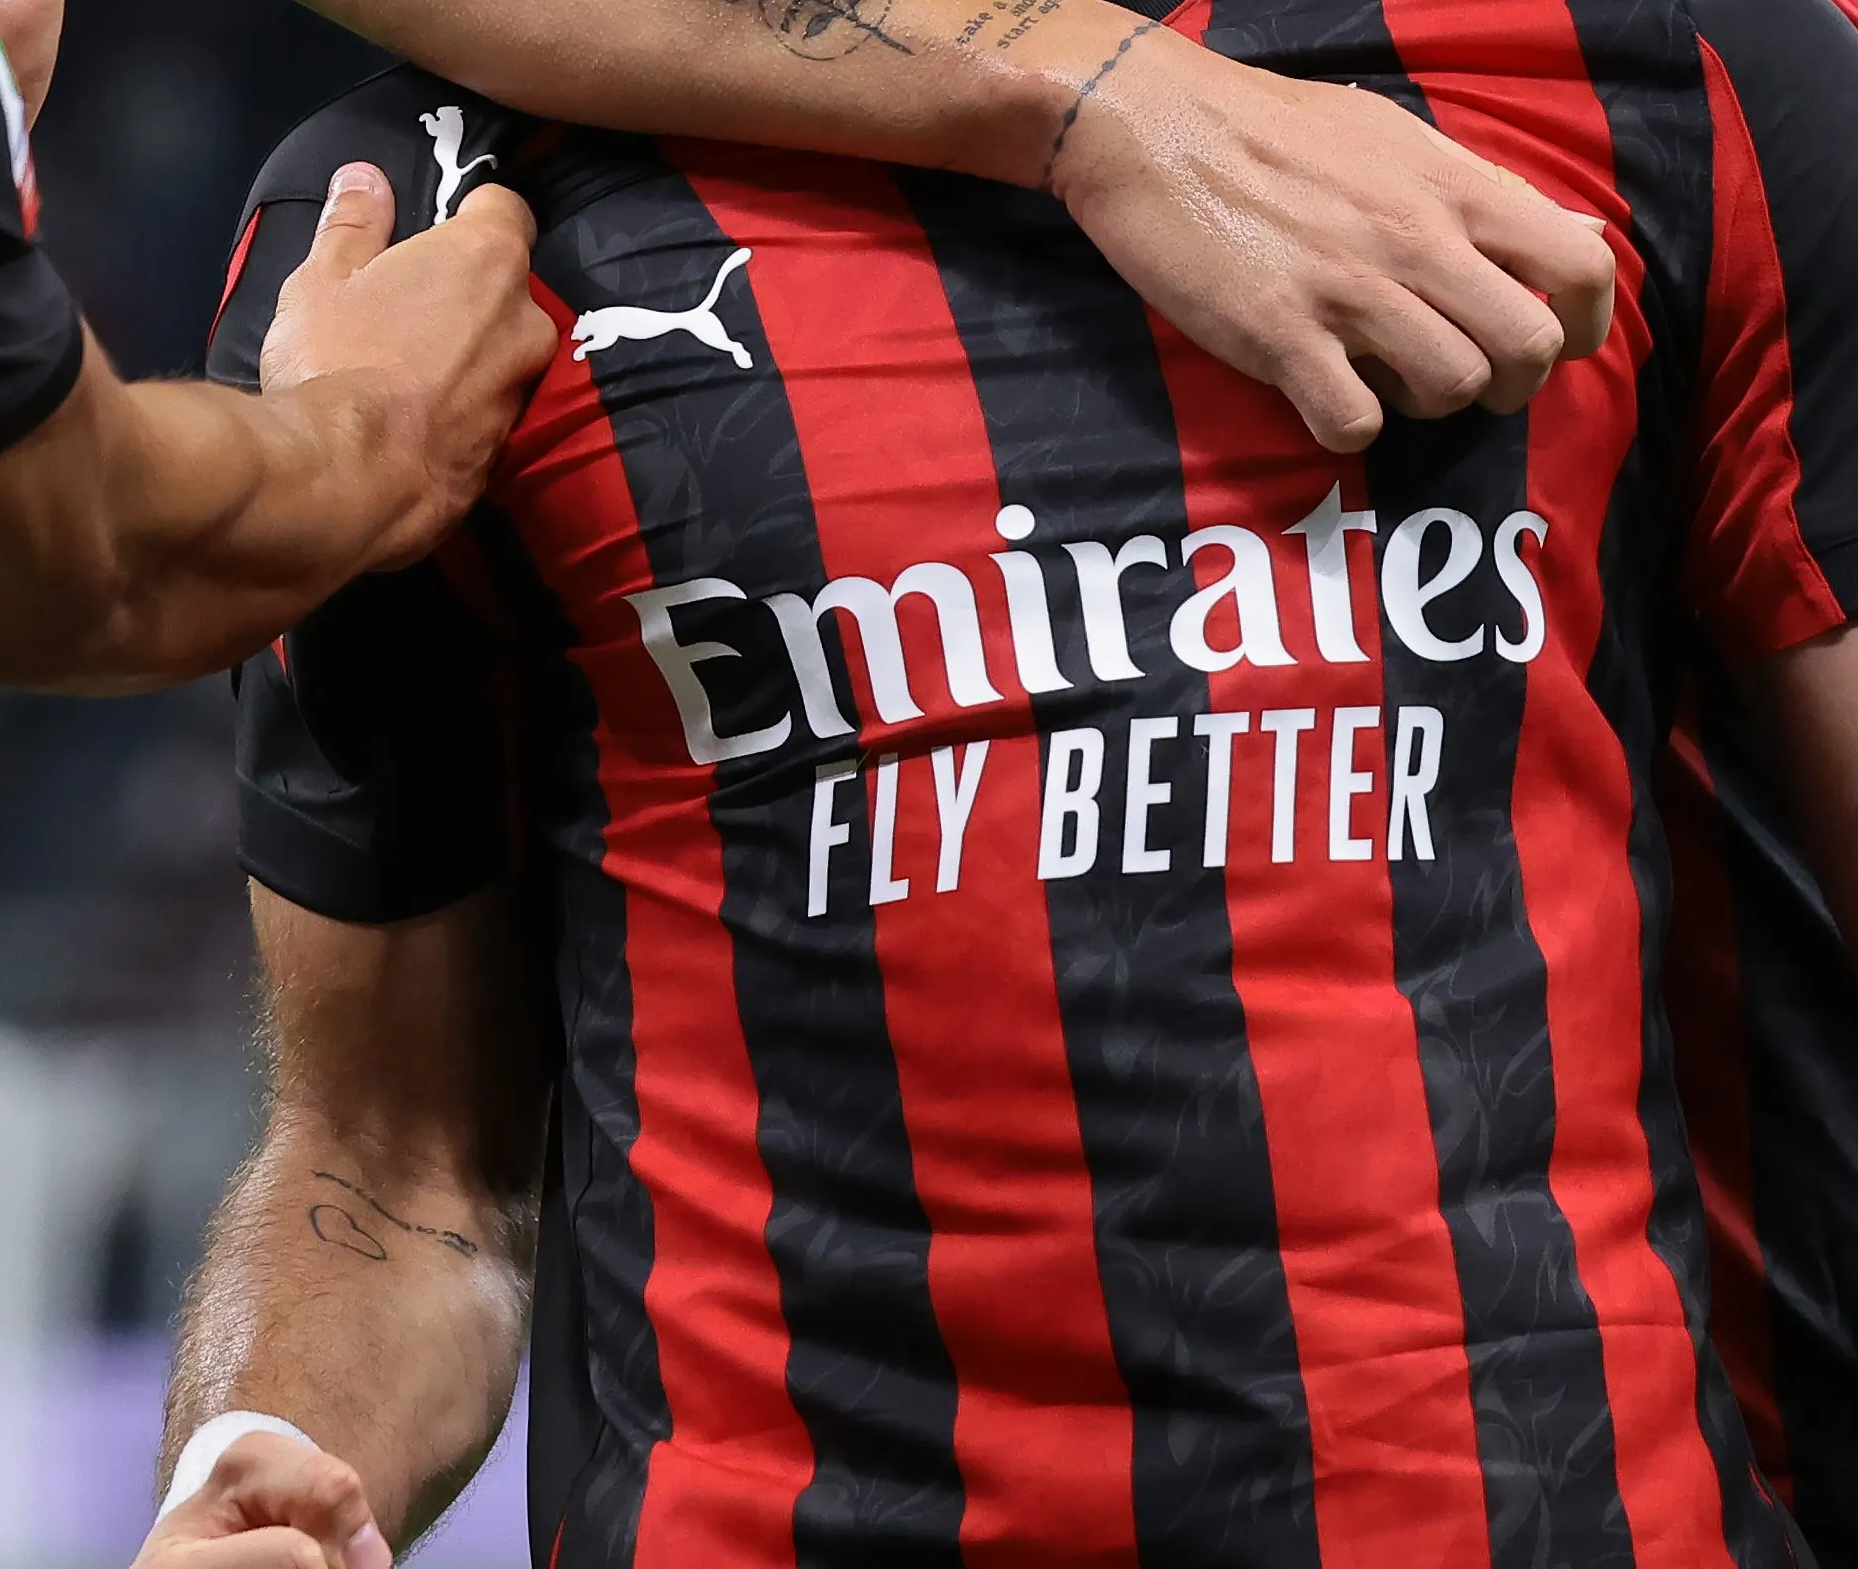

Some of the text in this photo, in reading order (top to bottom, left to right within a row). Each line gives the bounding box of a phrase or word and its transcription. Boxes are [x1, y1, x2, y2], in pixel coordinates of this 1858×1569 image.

[997, 16, 1040, 49] start
[622, 479, 1549, 765] Emirates
[806, 705, 1445, 918] FLY BETTER
